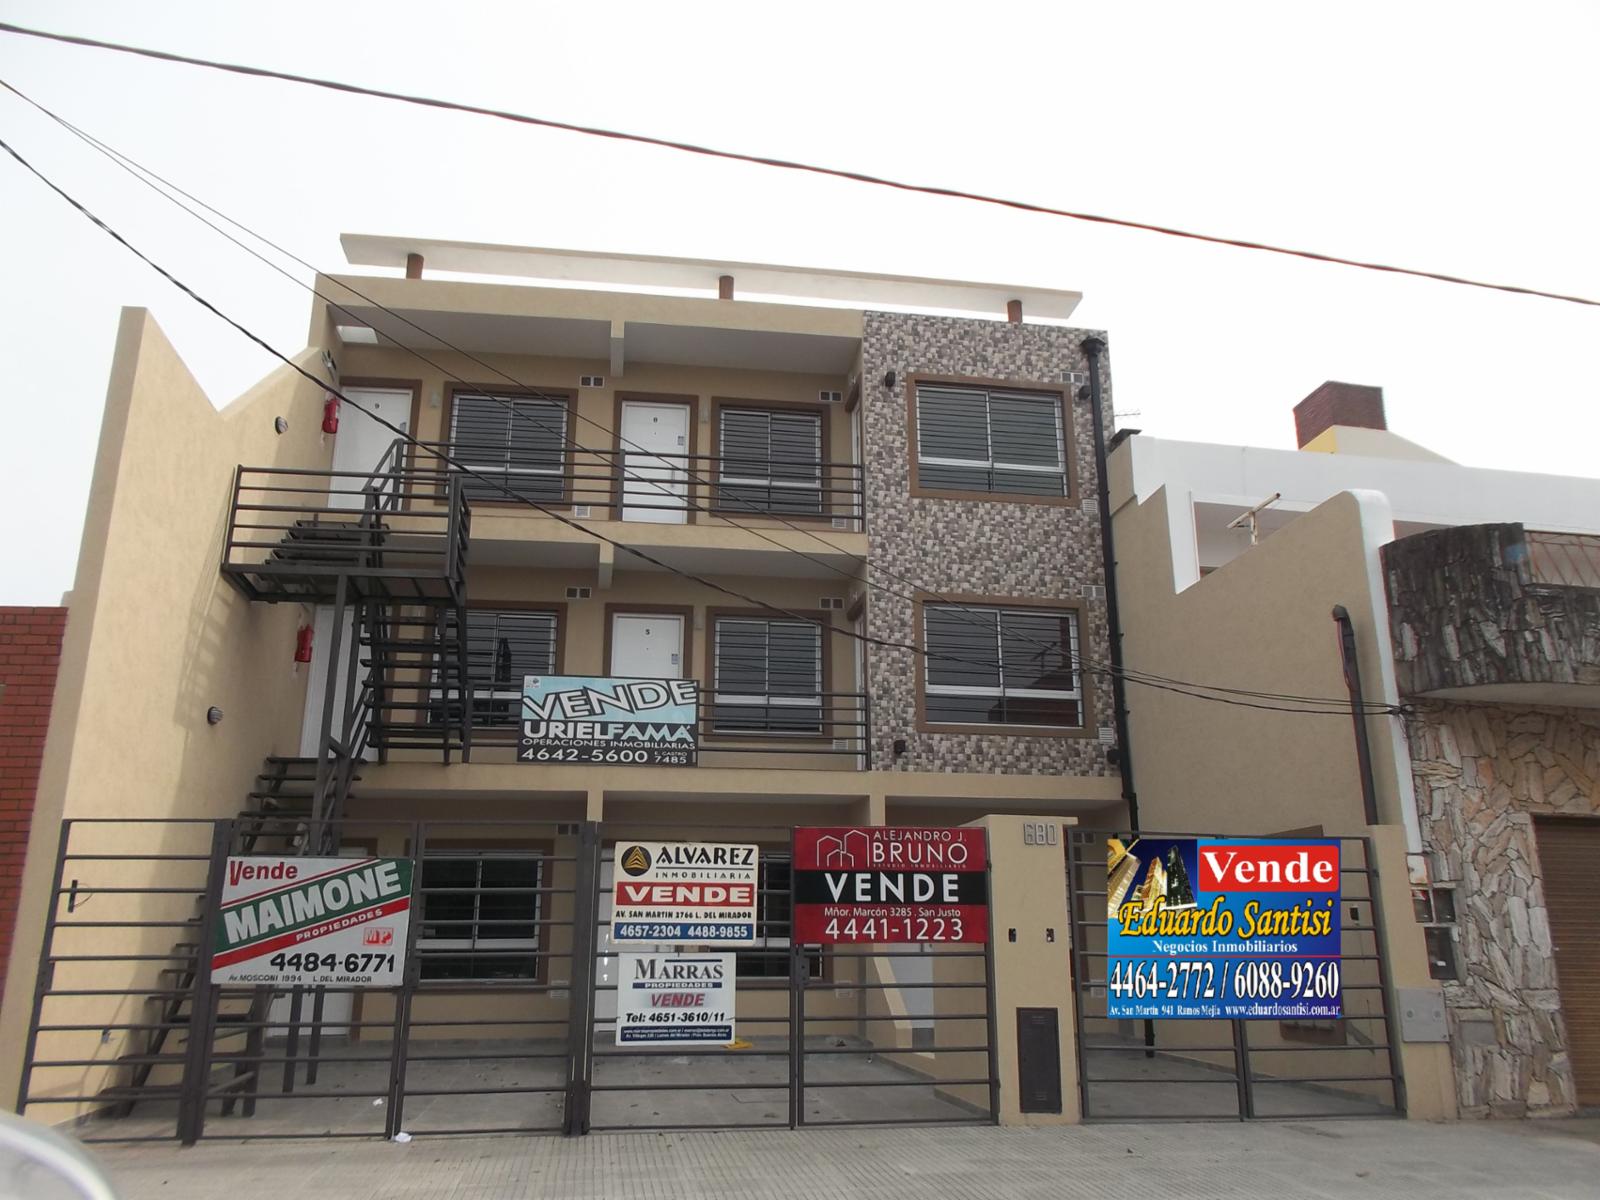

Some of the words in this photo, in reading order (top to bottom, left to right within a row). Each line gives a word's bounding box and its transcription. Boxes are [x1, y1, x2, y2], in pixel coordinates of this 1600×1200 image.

[523, 680, 697, 720] VENDE
[522, 738, 606, 747] OPERACIONES
[610, 739, 695, 750] INMOBILIARIAS
[521, 748, 648, 763] 4642-5600
[654, 755, 687, 764] 7485
[873, 830, 951, 842] ALEJANDRO
[957, 831, 967, 842] J.
[656, 846, 754, 865] ALVAREZ
[873, 842, 968, 864] BRUNO
[229, 860, 298, 886] Vende
[1202, 851, 1333, 883] Vende
[624, 885, 751, 903] VENDE
[824, 872, 959, 903] VENDE
[224, 861, 401, 944] MAIMONE
[890, 907, 912, 917] 3285
[918, 908, 935, 917] San
[937, 908, 961, 917] Justo
[615, 910, 626, 918] AV.
[1118, 895, 1233, 937] Eduardo
[1238, 899, 1334, 939] Santisi
[295, 908, 383, 942] PROPIEDADES
[620, 925, 681, 937] 4657-2304
[687, 925, 747, 938] 4488-9855
[825, 918, 963, 940] 4441-1223
[1152, 940, 1208, 956] Negocios
[1212, 940, 1298, 953] Inmobiliarios
[270, 953, 395, 972] 4484-6771
[634, 959, 723, 979] MARRAS
[1110, 961, 1215, 998] 4464-2772
[1234, 961, 1339, 999] 6088-9260
[651, 993, 705, 1008] VENDE
[1110, 1005, 1121, 1016] Av.
[1122, 1005, 1134, 1016] San
[1161, 1004, 1174, 1016] 941
[1177, 1004, 1200, 1016] Ramos
[1225, 1003, 1341, 1016] www.eduardosantisi.com.ar
[625, 1012, 646, 1022] Tel:
[649, 1011, 725, 1023] 4651-3610/11
